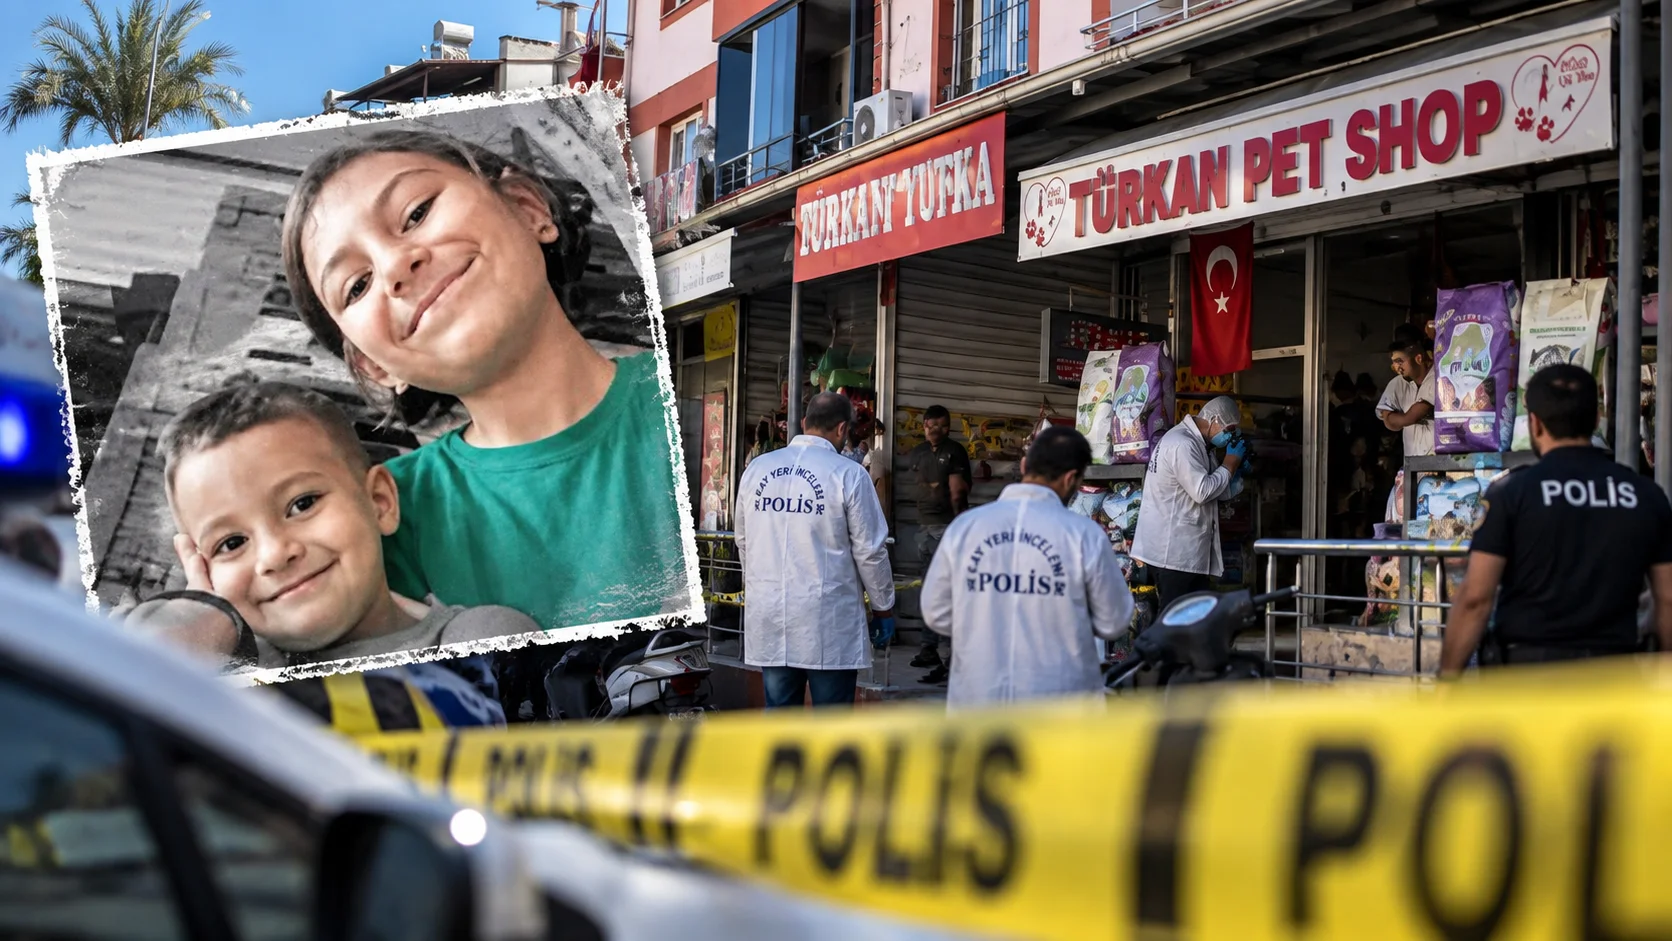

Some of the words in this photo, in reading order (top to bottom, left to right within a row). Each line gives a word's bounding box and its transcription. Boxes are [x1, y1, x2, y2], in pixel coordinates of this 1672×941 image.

[1069, 144, 1230, 238] TÜRKAN
[1243, 118, 1333, 204] PET
[1345, 79, 1504, 181] SHOP
[799, 173, 897, 257] TÜRKAN
[761, 493, 814, 514] POLİS
[1540, 475, 1639, 509] POLİS
[978, 568, 1052, 596] POLİS
